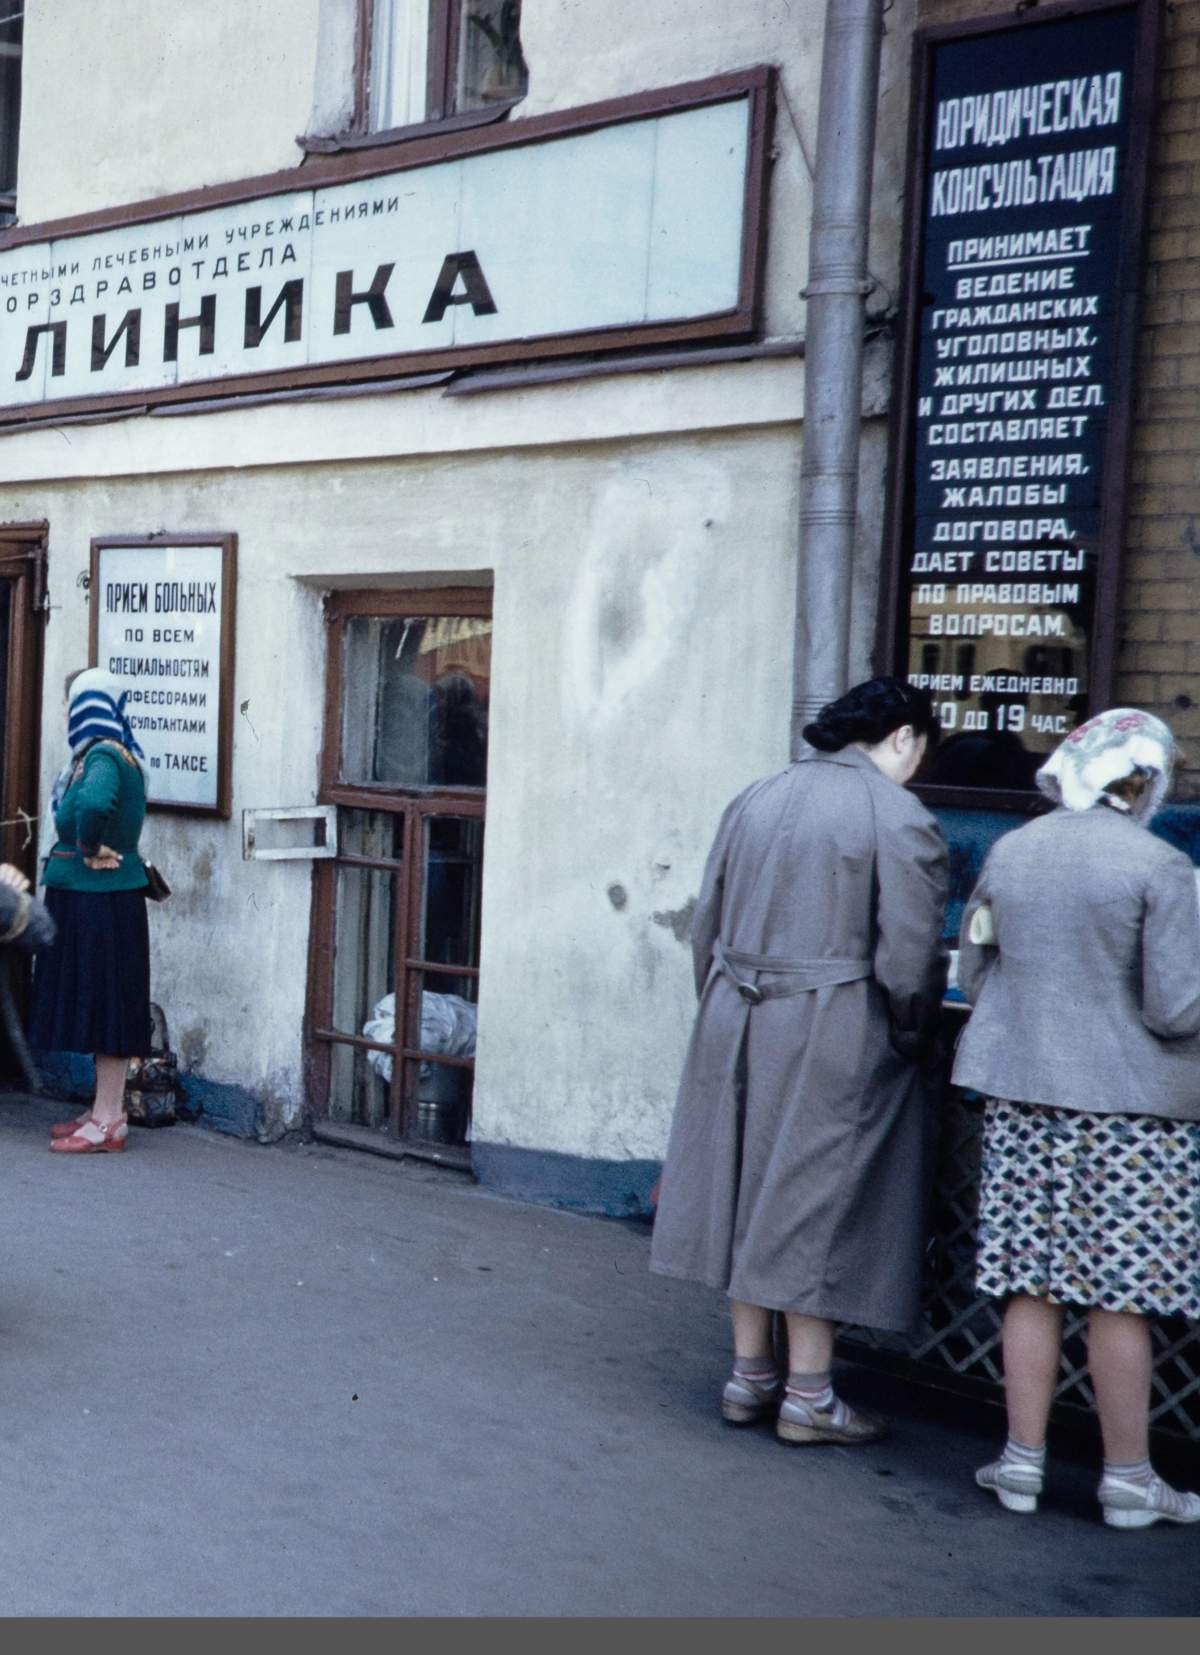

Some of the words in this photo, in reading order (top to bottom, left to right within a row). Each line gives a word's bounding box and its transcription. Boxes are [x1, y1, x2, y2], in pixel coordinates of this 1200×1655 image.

[936, 71, 1121, 150] ЮРИДИЧЕСКАЯ
[931, 147, 1116, 216] КОНСУЛЬТАЦИЯ
[92, 235, 209, 271] ЛЕЧЕБНЫМИ
[225, 196, 399, 244] УЧРЕЖДЕНИЯМИ
[948, 225, 1091, 263] ПРИНИМАЕТ
[956, 267, 1075, 299] ВЕДЕНИЕ
[932, 296, 1099, 329] ГРАЖДАНСКИХ
[937, 326, 1098, 358] УГОЛОВНЫХ,
[918, 397, 932, 417] И
[940, 389, 1038, 416] ДРУГИХ
[1046, 384, 1104, 409] ДЕЛ.
[928, 416, 1088, 445] СОСТАВЛЯЕТ
[930, 454, 1091, 481] ЗАЯВЛЕНИЯ,
[941, 484, 1067, 508] ЖАЛОБЫ
[932, 518, 1077, 541] ДОГОВОРА,
[911, 552, 975, 572] ДАЕТ
[985, 550, 1085, 572] СОВЕТЫ
[106, 582, 148, 613] ПРИЕМ
[154, 582, 216, 613] БОЛЬНЫХ
[918, 584, 945, 604] ПО
[956, 584, 1079, 604] ПРАВОВЫМ
[125, 629, 144, 642] ПО
[153, 629, 195, 643] ВСЕМ
[928, 614, 1066, 636] ВОПРОСАМ.
[109, 656, 209, 677] СПЕЦИАЛЬНОСТЯМ
[970, 675, 1078, 695] ЕЖЕДНЕВНО
[997, 704, 1026, 732] 19
[164, 753, 208, 773] ТАКСЕ
